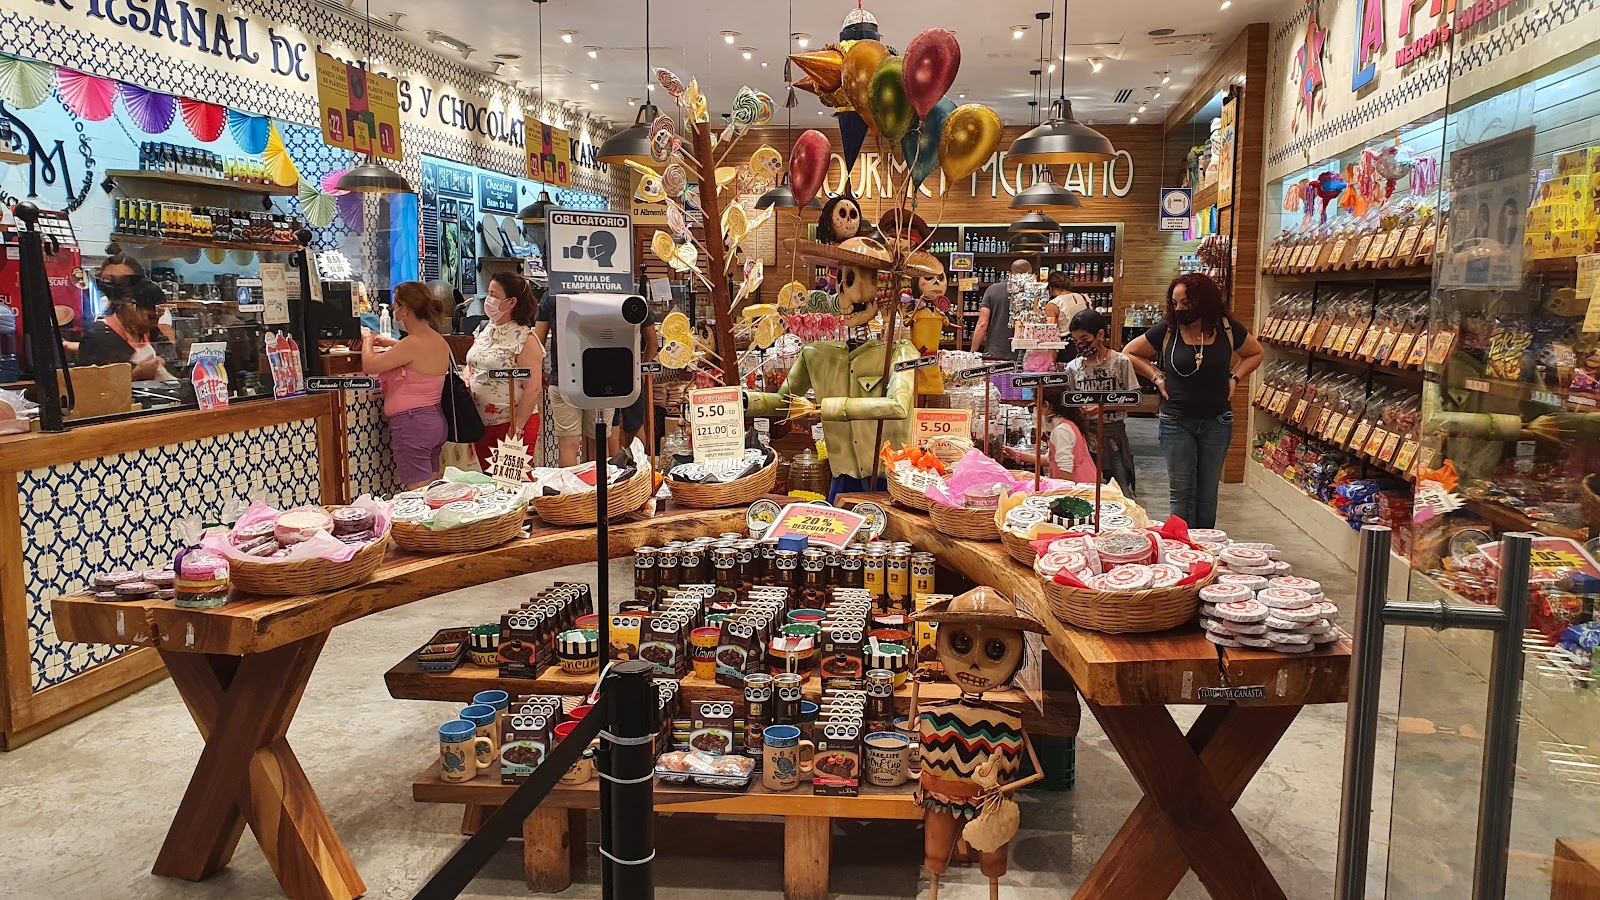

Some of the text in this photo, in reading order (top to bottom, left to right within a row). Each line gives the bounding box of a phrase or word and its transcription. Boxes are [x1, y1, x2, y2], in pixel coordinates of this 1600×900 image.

[1394, 21, 1450, 69] MEXICO'S
[268, 28, 310, 82] DE
[438, 94, 526, 150] CHOCOLAT
[485, 178, 513, 194] Chocolate
[486, 198, 514, 210] Bean to bar
[554, 214, 625, 227] OBLIGATORIO
[48, 276, 70, 286] SCAFÉ
[573, 275, 611, 283] TOMA DE
[561, 281, 622, 290] TEMPERATURA
[698, 394, 733, 402] EVERYTHING
[1071, 393, 1094, 404] Café
[1106, 393, 1135, 404] Coffee
[697, 404, 725, 418] 5.50
[696, 425, 727, 436] 121.00
[920, 422, 951, 433] 5.50
[492, 449, 499, 463] 3
[493, 464, 499, 475] 6
[504, 467, 522, 481] 417.78
[801, 516, 821, 525] 20
[791, 523, 835, 533] DESCUENTO
[1234, 689, 1263, 698] CANASTA
